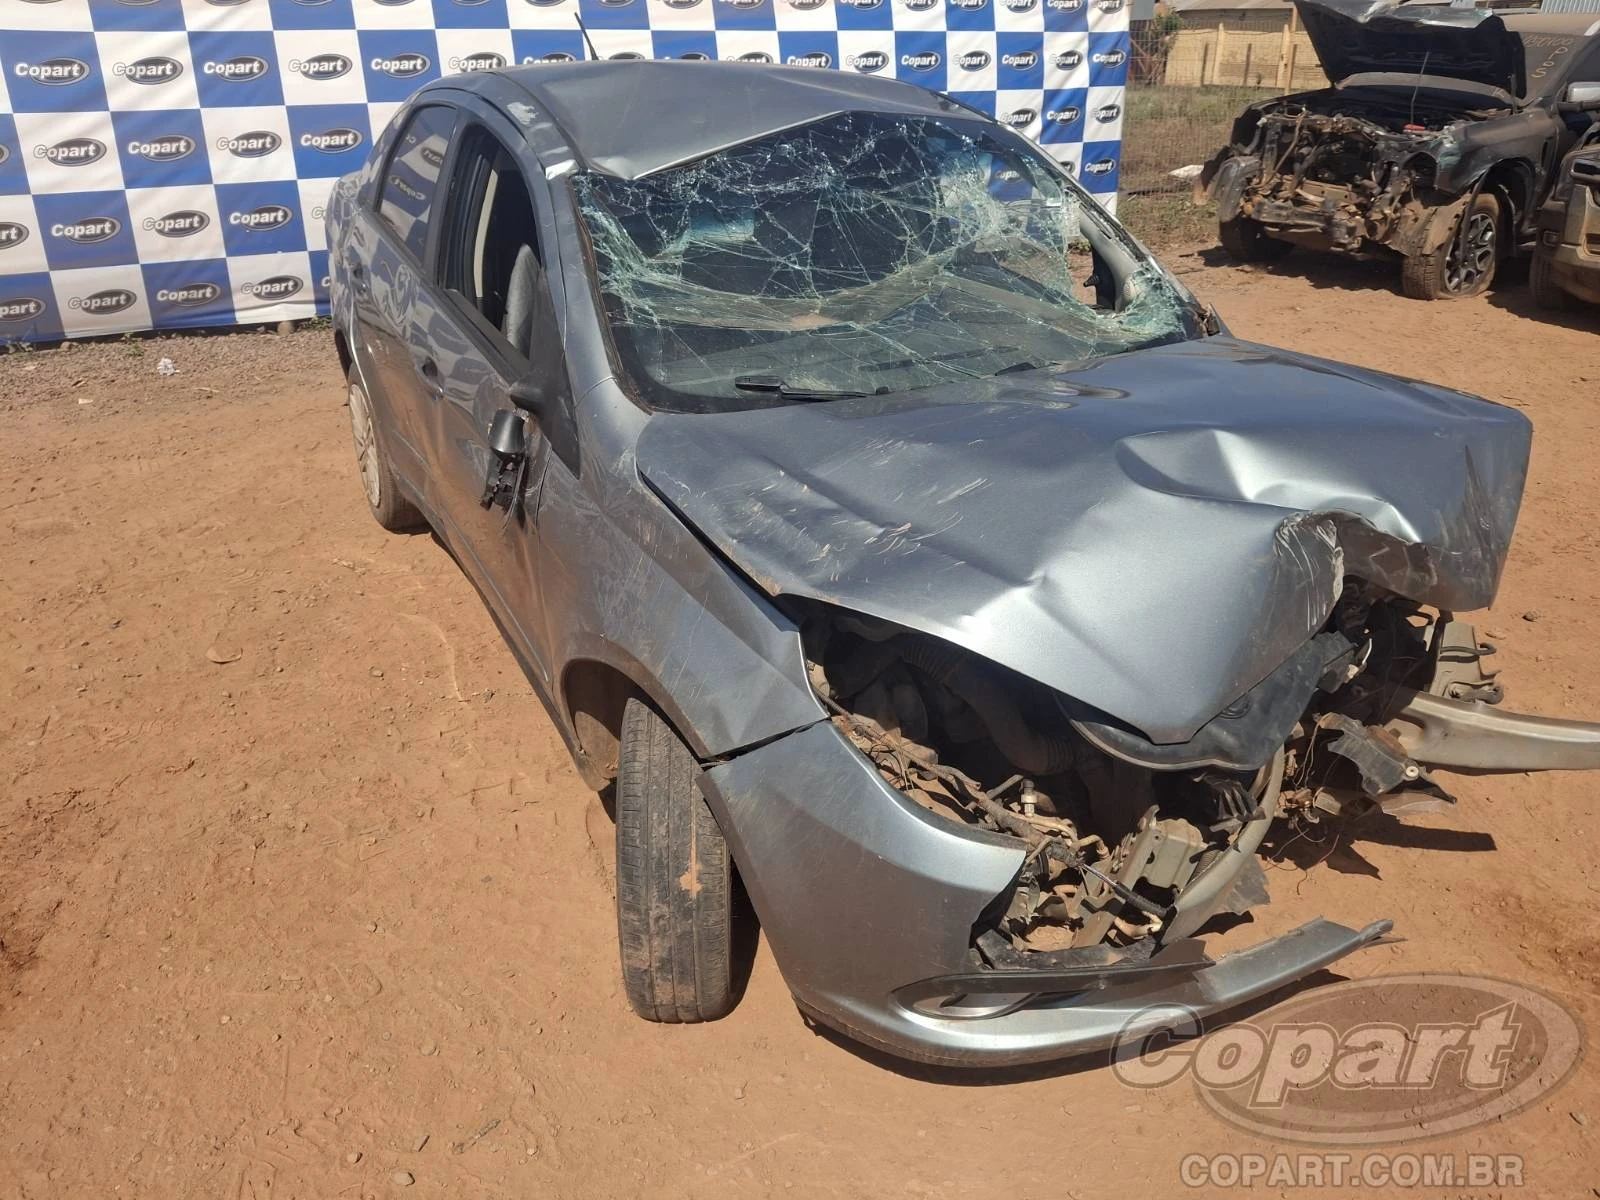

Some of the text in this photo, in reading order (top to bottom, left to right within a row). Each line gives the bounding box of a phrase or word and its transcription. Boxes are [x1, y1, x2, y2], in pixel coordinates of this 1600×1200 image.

[288, 58, 344, 74] Copart
[371, 58, 424, 73] Copart
[449, 56, 498, 71] Copart
[787, 55, 826, 67] Copart
[846, 54, 881, 67] Copart
[901, 54, 936, 67] Copart
[953, 54, 985, 67] Copart
[1002, 54, 1038, 67] Copart
[1050, 54, 1078, 67] Copart
[1093, 53, 1122, 66] Copart
[15, 62, 81, 79] Copart
[112, 62, 173, 79] Copart
[203, 60, 260, 77] Copart
[1001, 111, 1033, 125] Copart
[1047, 109, 1078, 122] Copart
[1093, 107, 1118, 120] Copart
[128, 139, 188, 156] Copart
[216, 136, 273, 152] Copart
[300, 132, 354, 149] Copart
[34, 143, 96, 160] Copart
[1085, 161, 1114, 175] Copart
[143, 215, 200, 232] Copart
[229, 208, 285, 226] Copart
[51, 221, 113, 239] Copart
[157, 284, 213, 303] Copart
[241, 280, 295, 298] Copart
[0, 300, 37, 319] part
[68, 293, 127, 310] Copart
